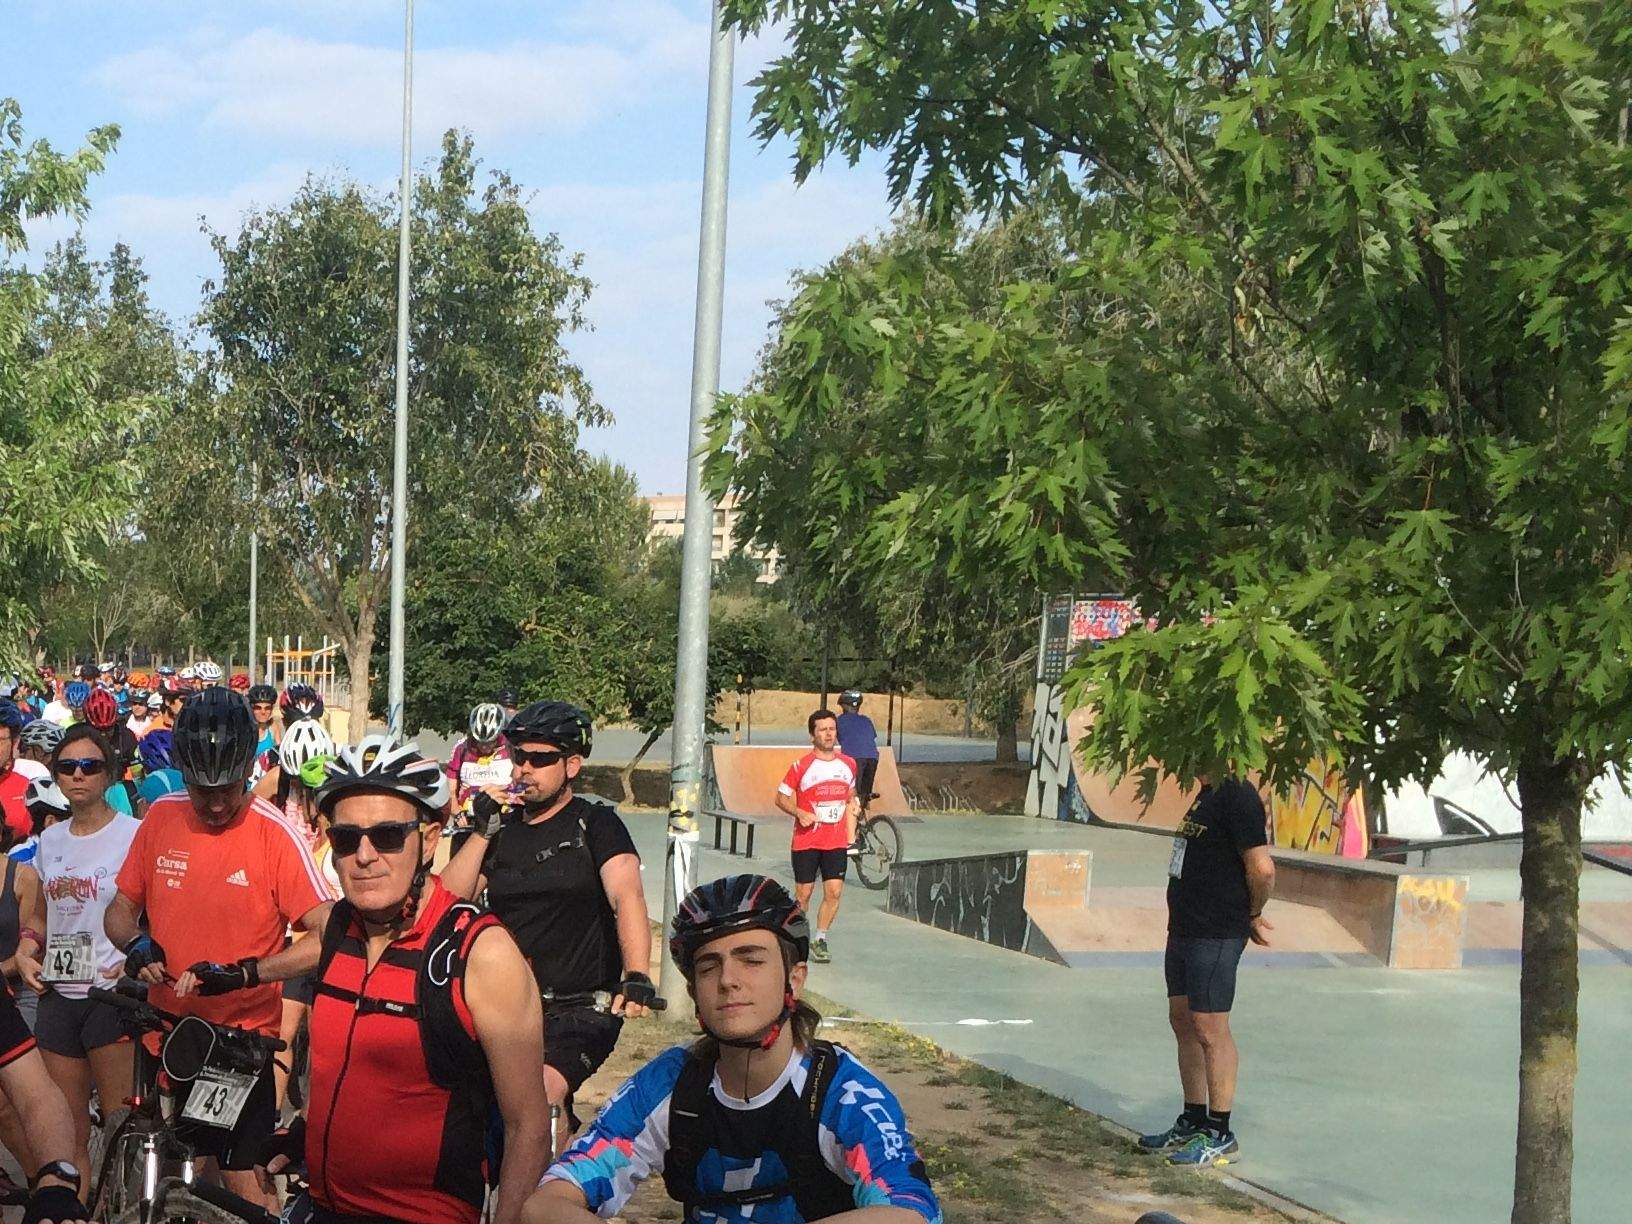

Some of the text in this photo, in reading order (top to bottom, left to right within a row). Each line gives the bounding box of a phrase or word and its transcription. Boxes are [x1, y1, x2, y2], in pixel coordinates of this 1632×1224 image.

[156, 855, 188, 871] Cursa
[53, 950, 74, 975] 42
[202, 1085, 228, 1117] 43
